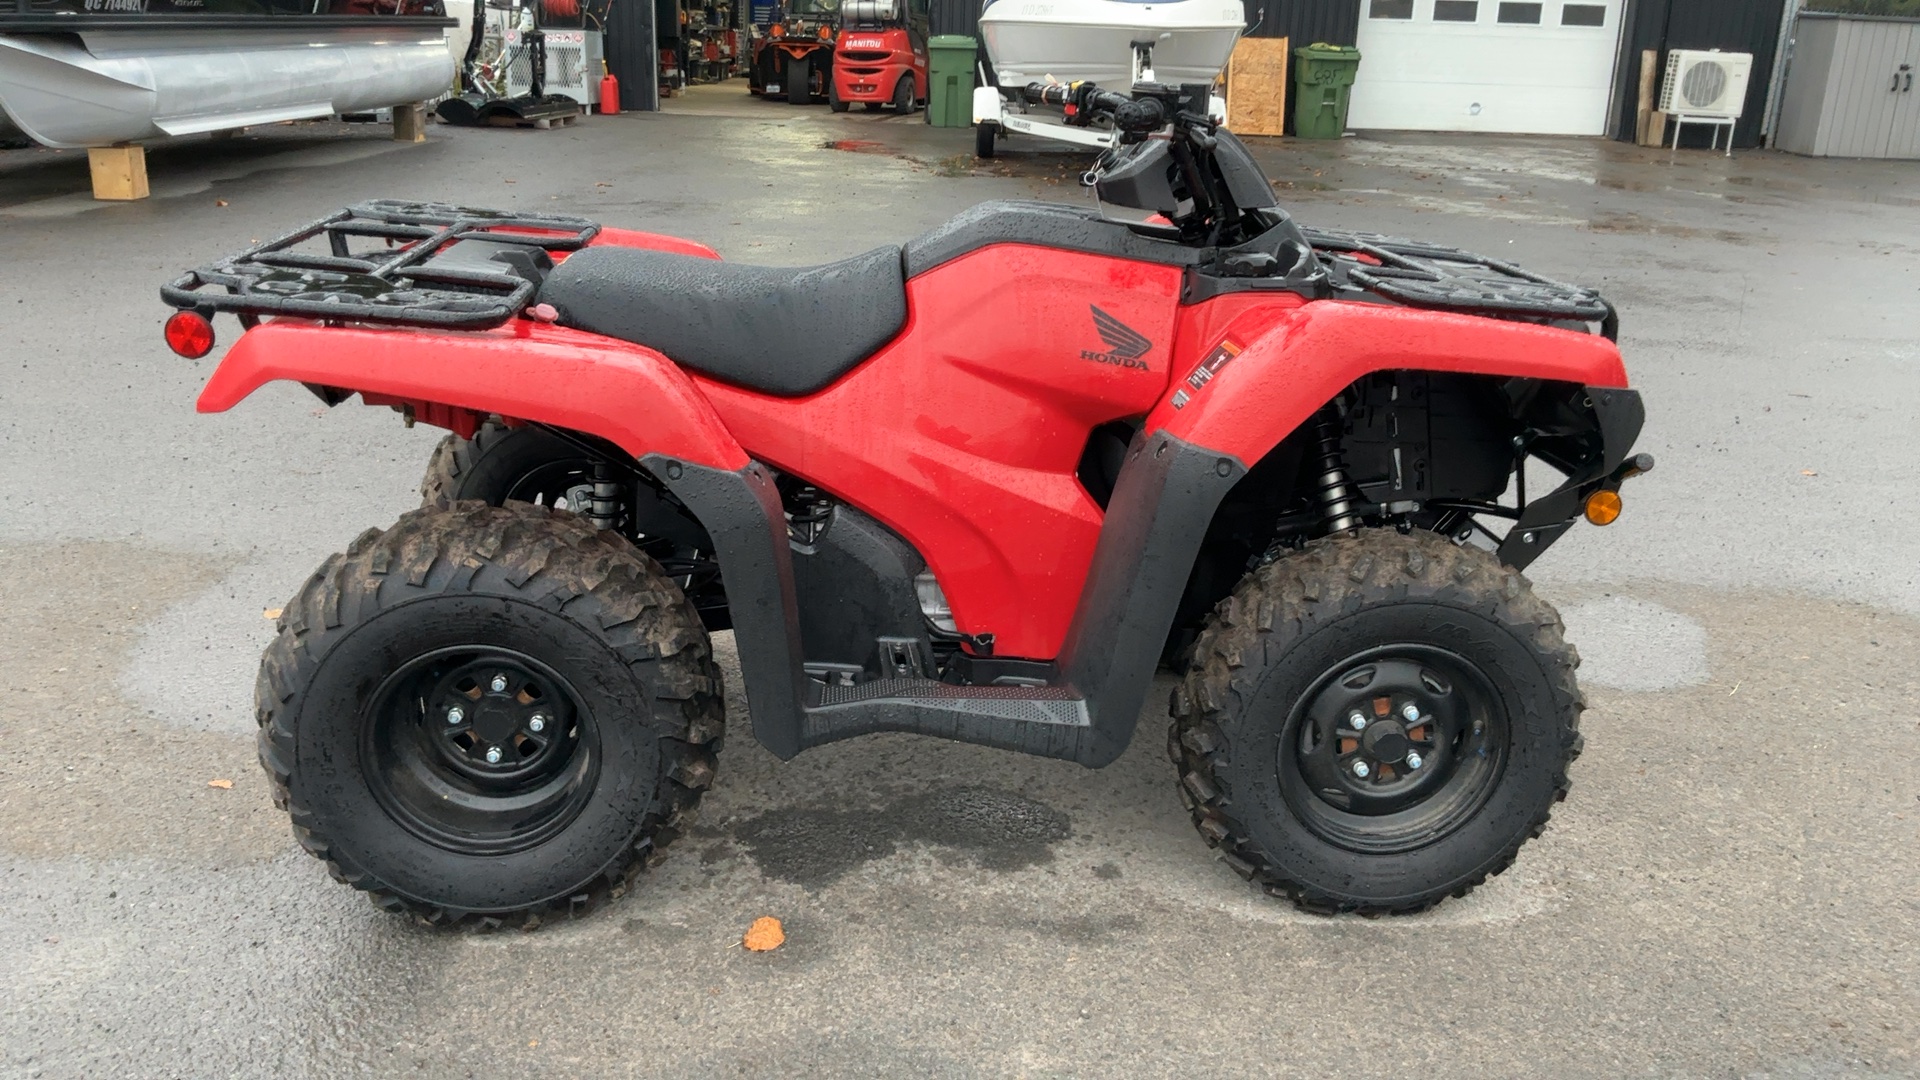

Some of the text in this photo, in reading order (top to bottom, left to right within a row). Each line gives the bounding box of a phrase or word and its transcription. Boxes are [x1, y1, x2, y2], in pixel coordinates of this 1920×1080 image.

[84, 0, 102, 10] QC
[845, 39, 881, 49] MANITOU
[1080, 350, 1149, 371] HONDA
